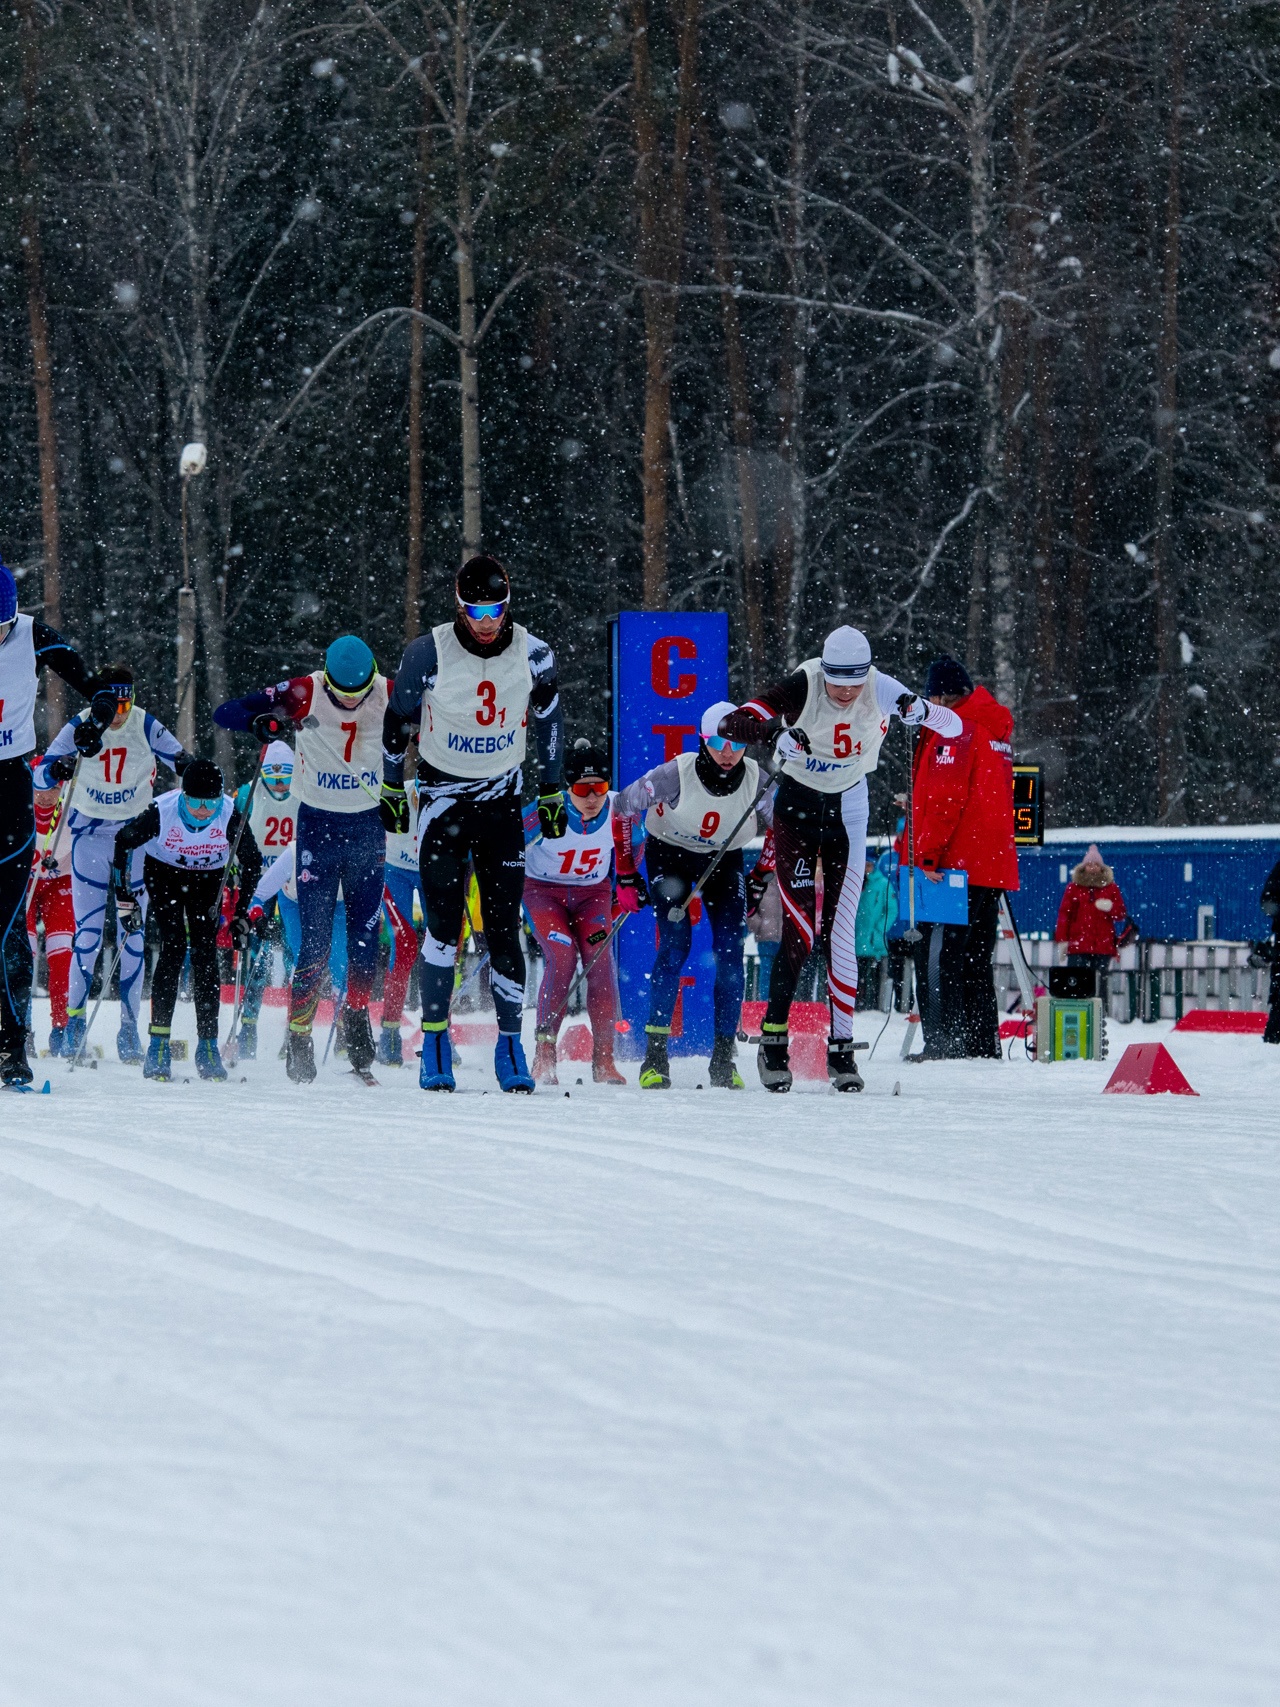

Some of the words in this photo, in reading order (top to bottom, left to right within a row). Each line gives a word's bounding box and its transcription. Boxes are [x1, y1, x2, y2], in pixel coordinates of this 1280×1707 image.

[476, 680, 496, 726] 3
[341, 721, 357, 762] 7
[447, 730, 517, 753] ИЖЕВСК
[549, 722, 558, 761] NORDSKI
[833, 723, 852, 758] 5
[99, 747, 127, 784] 17
[936, 755, 955, 765] УДМ
[317, 770, 379, 790] ИЖЕВСК
[86, 786, 138, 804] ИЖЕВСК
[264, 817, 294, 846] 29
[700, 811, 720, 838] 9
[558, 848, 601, 875] 15
[791, 879, 815, 889] Löffle
